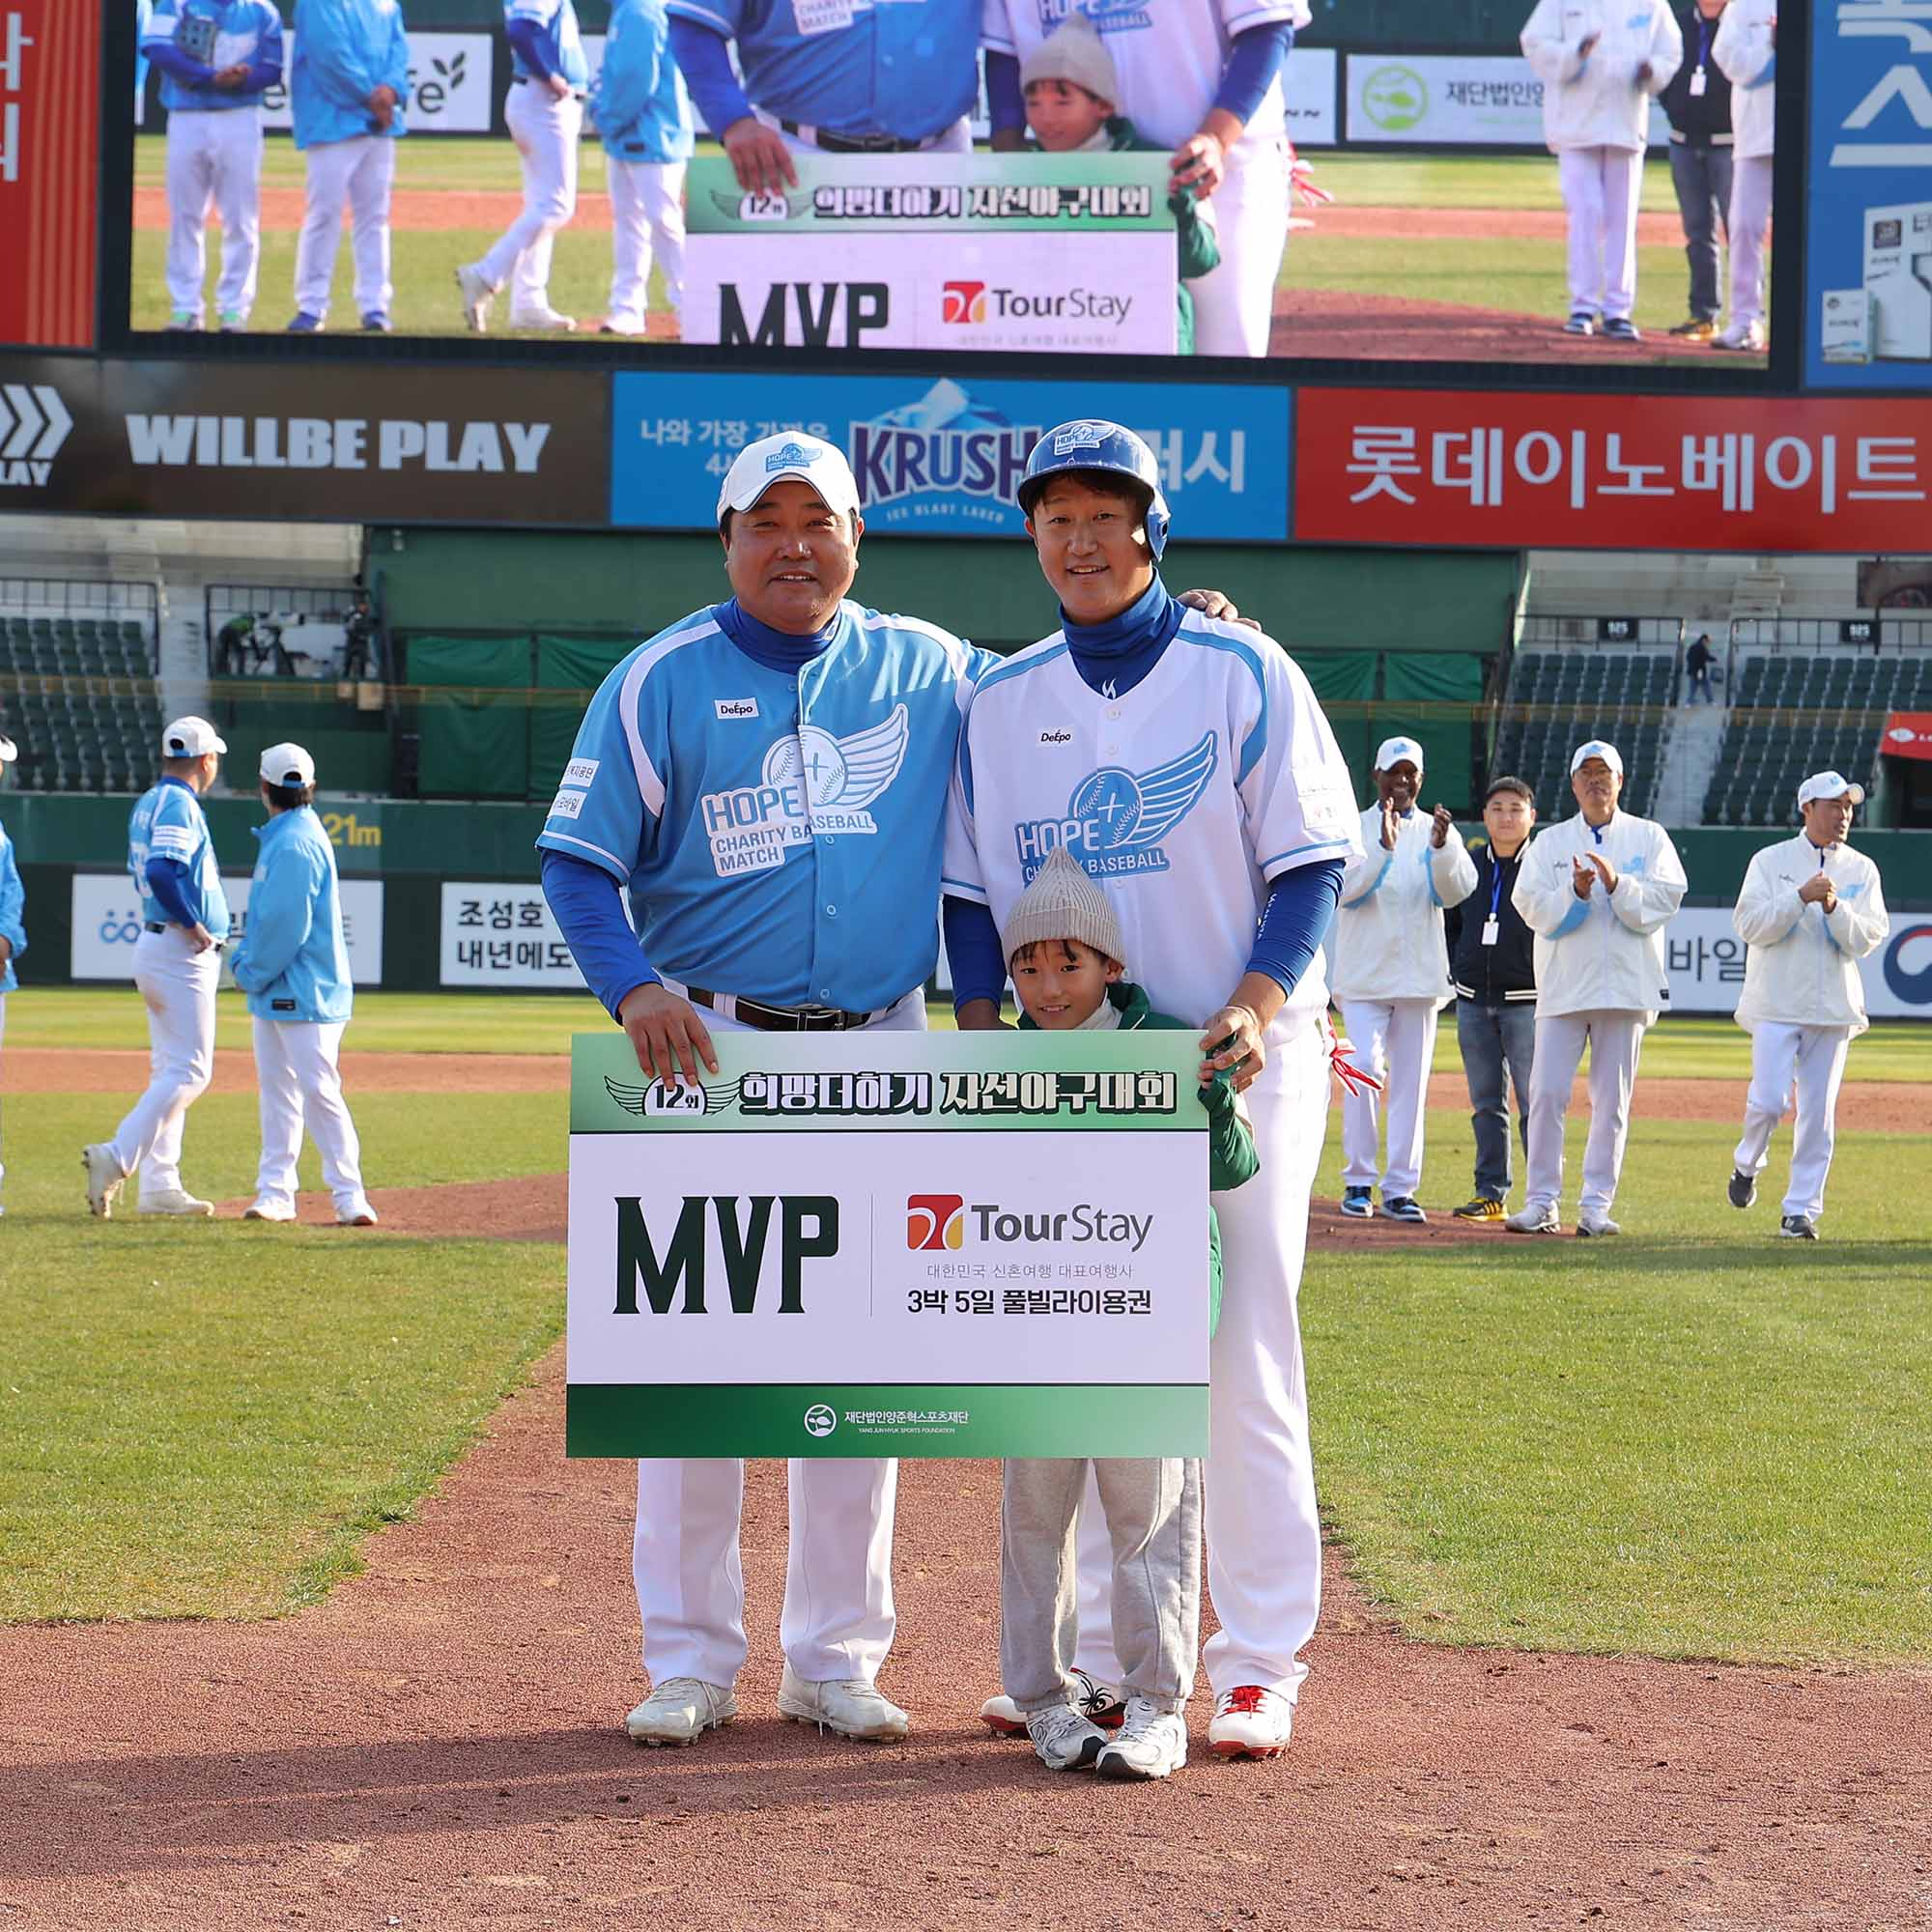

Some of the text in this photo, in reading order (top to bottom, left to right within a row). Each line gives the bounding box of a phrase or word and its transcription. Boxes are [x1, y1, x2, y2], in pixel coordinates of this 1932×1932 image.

[719, 282, 889, 349] MVP
[992, 289, 1133, 325] TourStay
[125, 413, 552, 473] WILLBE PLAY
[641, 418, 693, 446] 나와
[698, 418, 750, 447] 가장
[849, 422, 1043, 509] KRUSH
[1346, 425, 1926, 514] 롯데이노베이트
[705, 784, 805, 832] HOPE
[716, 814, 873, 854] CHARITY BASEBALL
[1017, 818, 1099, 860] HOPE
[719, 847, 780, 872] MATCH
[1088, 851, 1166, 873] BASEBALL
[458, 900, 544, 929] 조성호
[458, 940, 573, 970] 내년에도
[740, 1072, 931, 1114] 희망더하기
[940, 1071, 1177, 1114] 자선야구대회
[971, 1204, 1154, 1253] TourStay
[612, 1195, 839, 1315] MVP
[926, 1263, 1135, 1280] 대한민국 신혼여행 대표여행사
[907, 1289, 1151, 1315] 3박 5일 풀빌라이용권
